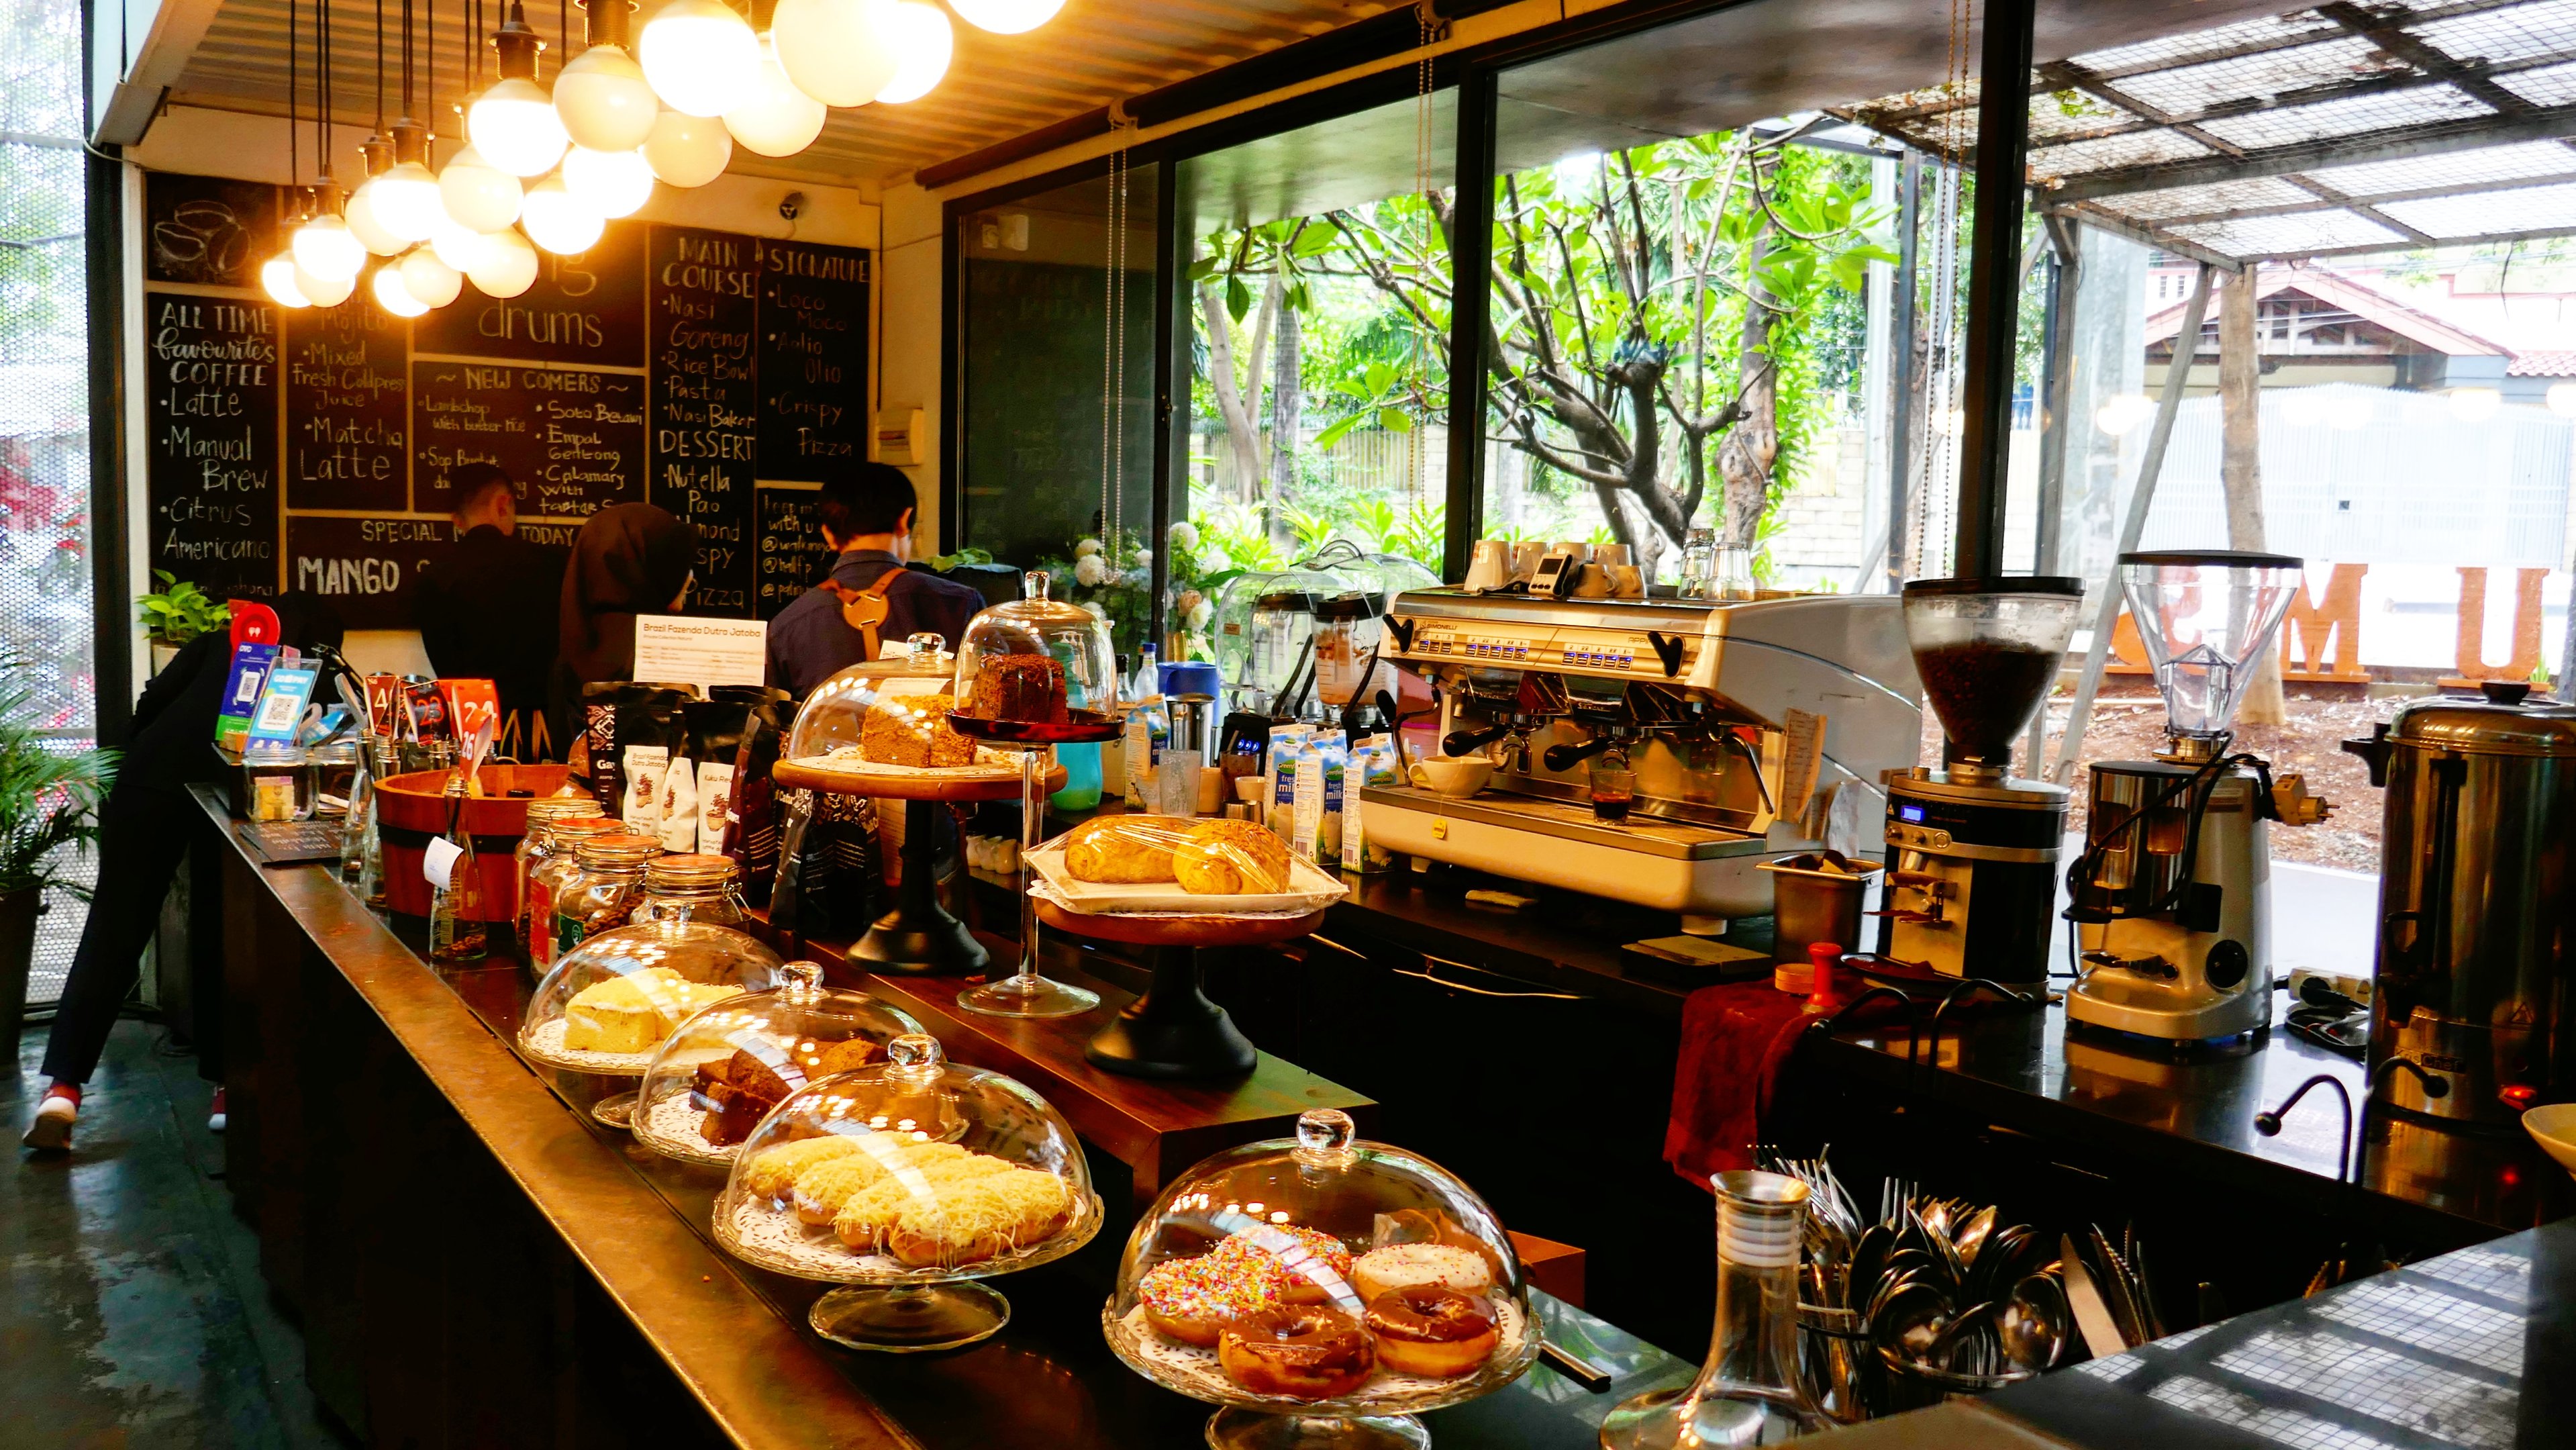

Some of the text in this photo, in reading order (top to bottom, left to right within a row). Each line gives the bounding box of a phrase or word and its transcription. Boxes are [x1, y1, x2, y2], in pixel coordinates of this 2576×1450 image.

[679, 237, 738, 267] MAIN
[769, 248, 870, 283] SIGNATURE
[662, 263, 754, 298] COURSE
[668, 293, 714, 320] Nasi
[777, 284, 826, 310] Loco
[160, 303, 273, 334] ALL TIME
[479, 299, 603, 347] drums
[797, 310, 847, 331] Moco
[152, 327, 275, 362] favourites
[310, 340, 366, 366] Mixed
[671, 321, 748, 359] Goreng
[170, 361, 268, 386] COFFEE
[293, 363, 336, 387] Fresh
[667, 351, 754, 381] Rice Bowl
[805, 358, 842, 383] Olio
[465, 368, 601, 394] NEW COMERS
[669, 375, 726, 401] Pasta
[171, 386, 242, 417] Latte
[548, 400, 592, 420] Soto
[669, 403, 705, 423] Nasi
[779, 391, 842, 428] Crispy
[170, 425, 251, 461] Manual
[313, 417, 403, 449] Matcha
[546, 424, 602, 450] Empal
[660, 430, 755, 461] DESSERT
[797, 427, 852, 456] Pizza
[198, 459, 267, 491] Brew
[301, 445, 391, 480] Latte
[546, 465, 625, 490] Calamary
[668, 464, 730, 493] Nutella
[170, 497, 252, 526] Citrus
[689, 490, 720, 514] Pao
[163, 528, 269, 560] Americano
[362, 521, 442, 544] SPECIAL
[521, 526, 574, 547] TODAY
[299, 556, 401, 595] MANGO
[644, 624, 760, 637] Brazil Fazenda Dutra Jatoba
[375, 688, 389, 710] 4
[1279, 783, 1294, 792] mil
[1326, 791, 1342, 800] milk
